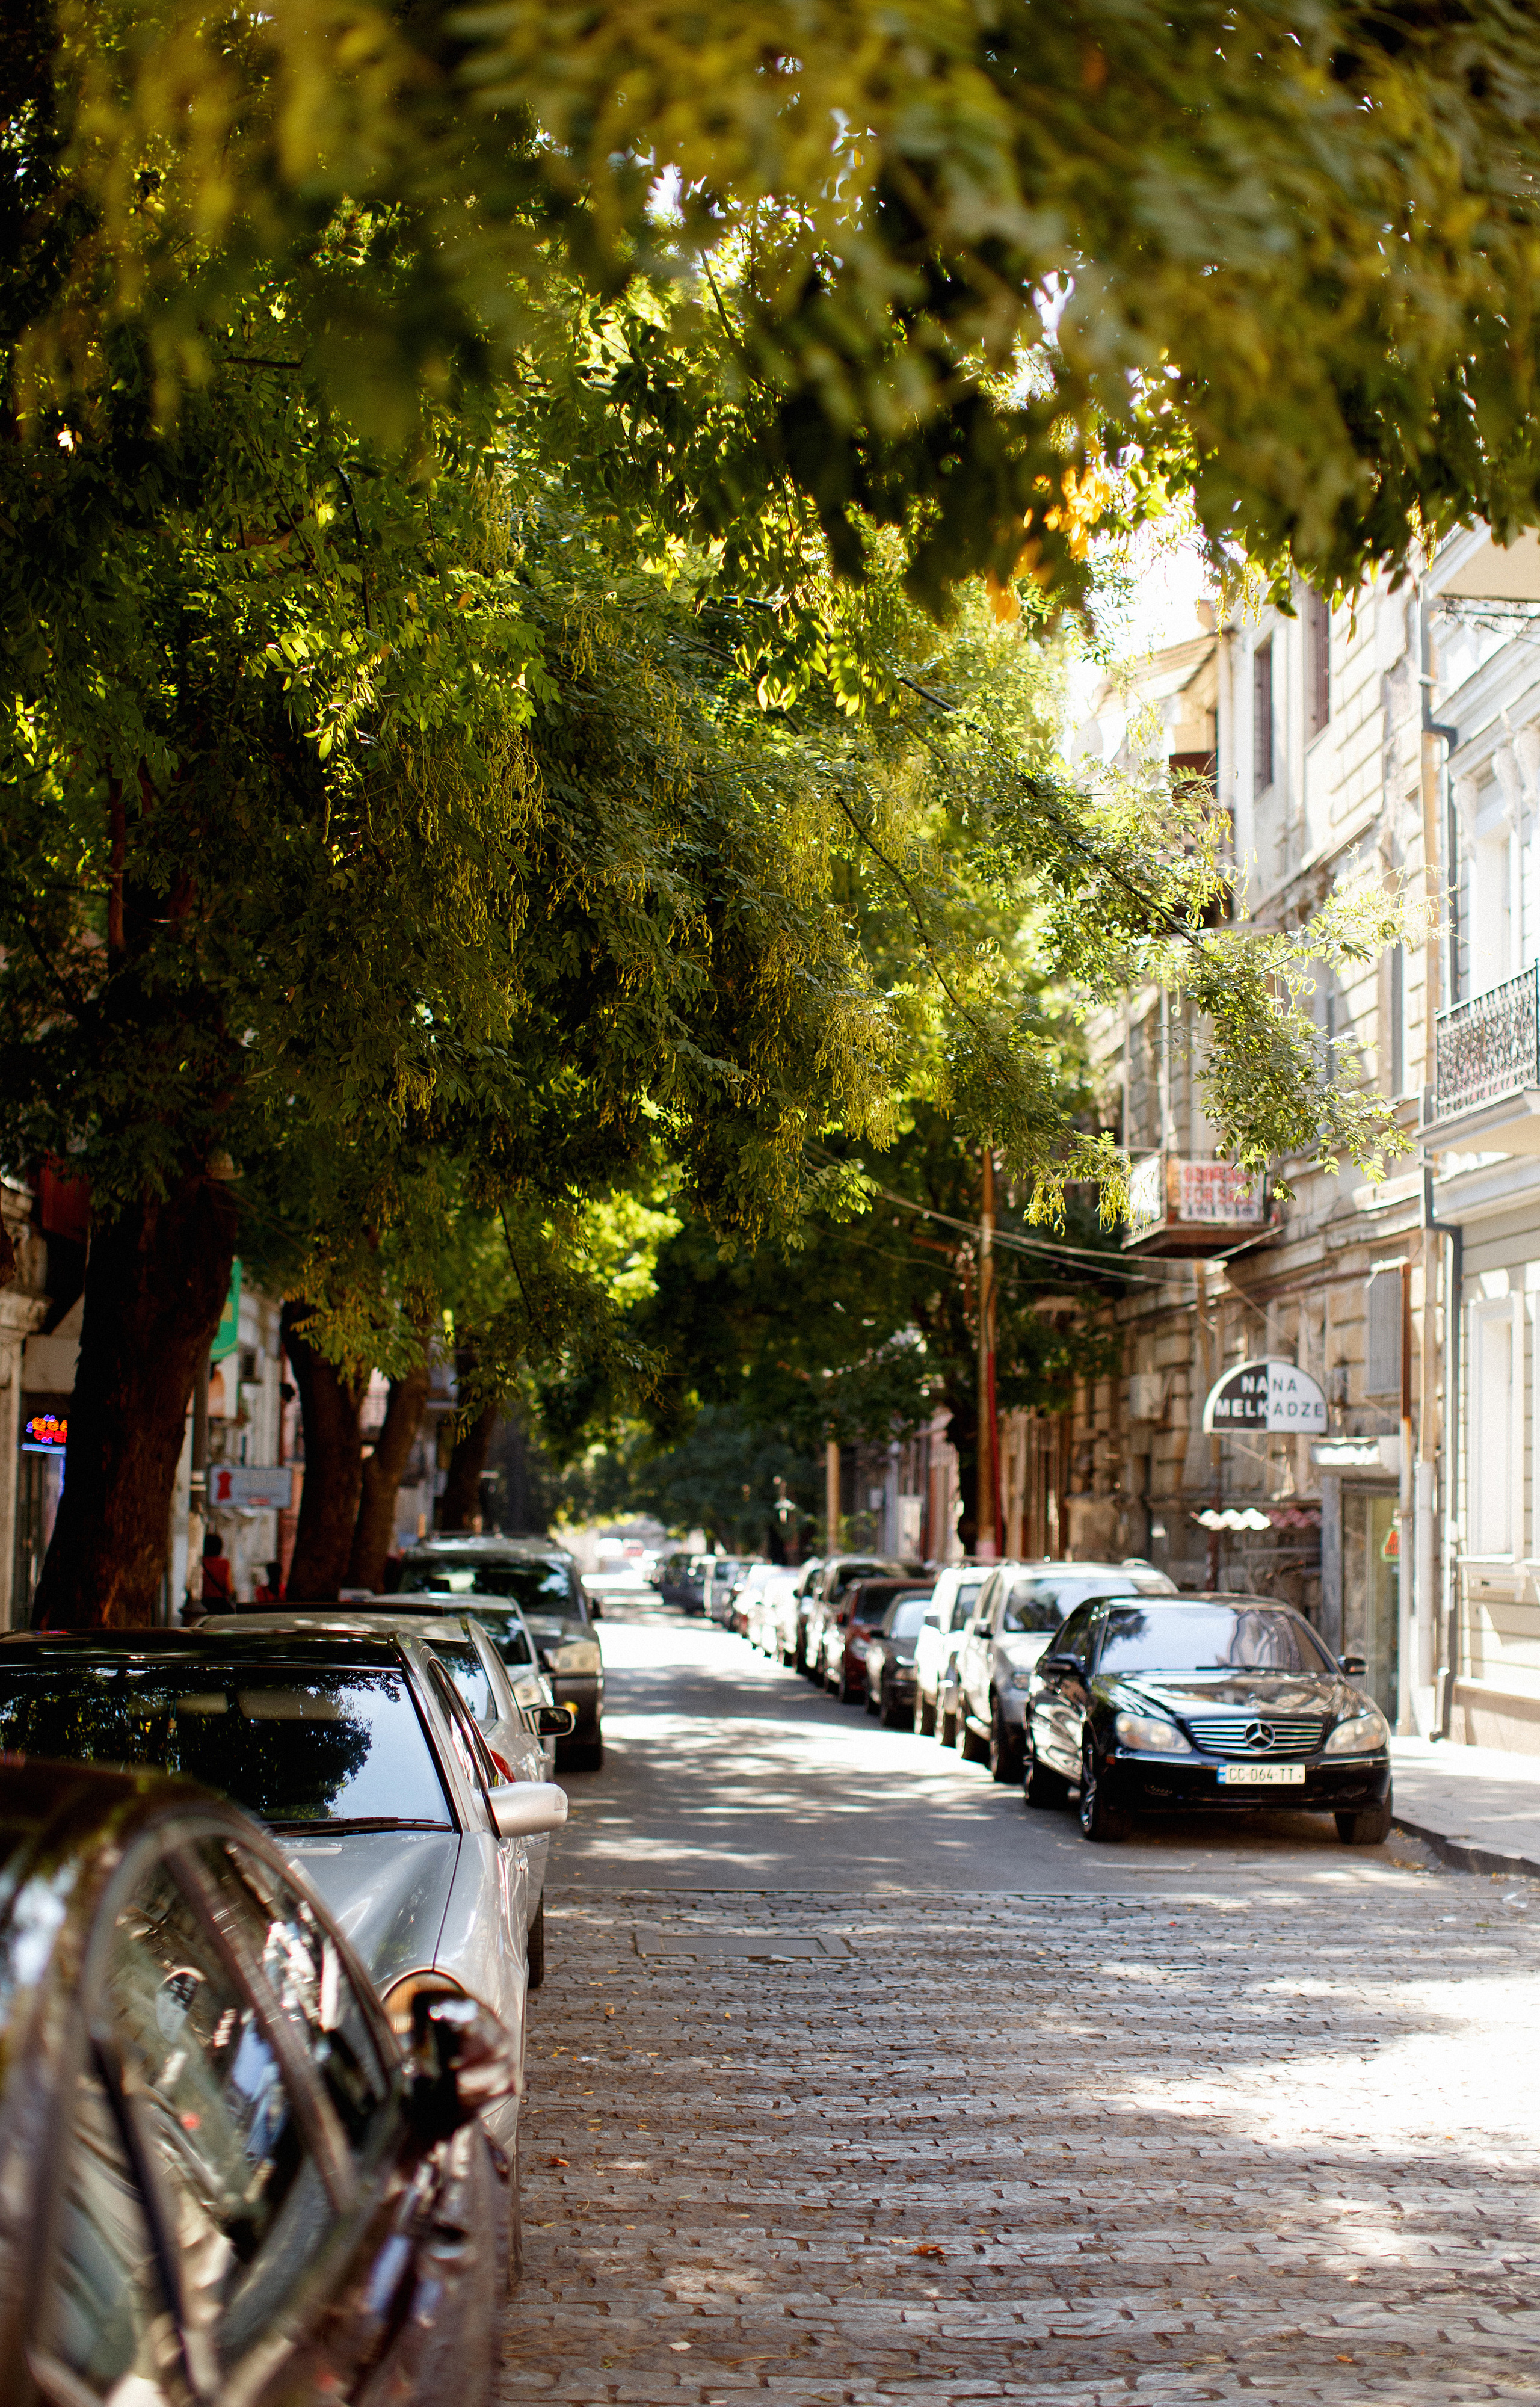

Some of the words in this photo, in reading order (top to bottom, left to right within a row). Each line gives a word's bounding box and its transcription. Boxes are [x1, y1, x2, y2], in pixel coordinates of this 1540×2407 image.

[1185, 1186, 1213, 1204] FOR
[1241, 1375, 1296, 1393] NANA
[1215, 1398, 1323, 1417] MELKADZE
